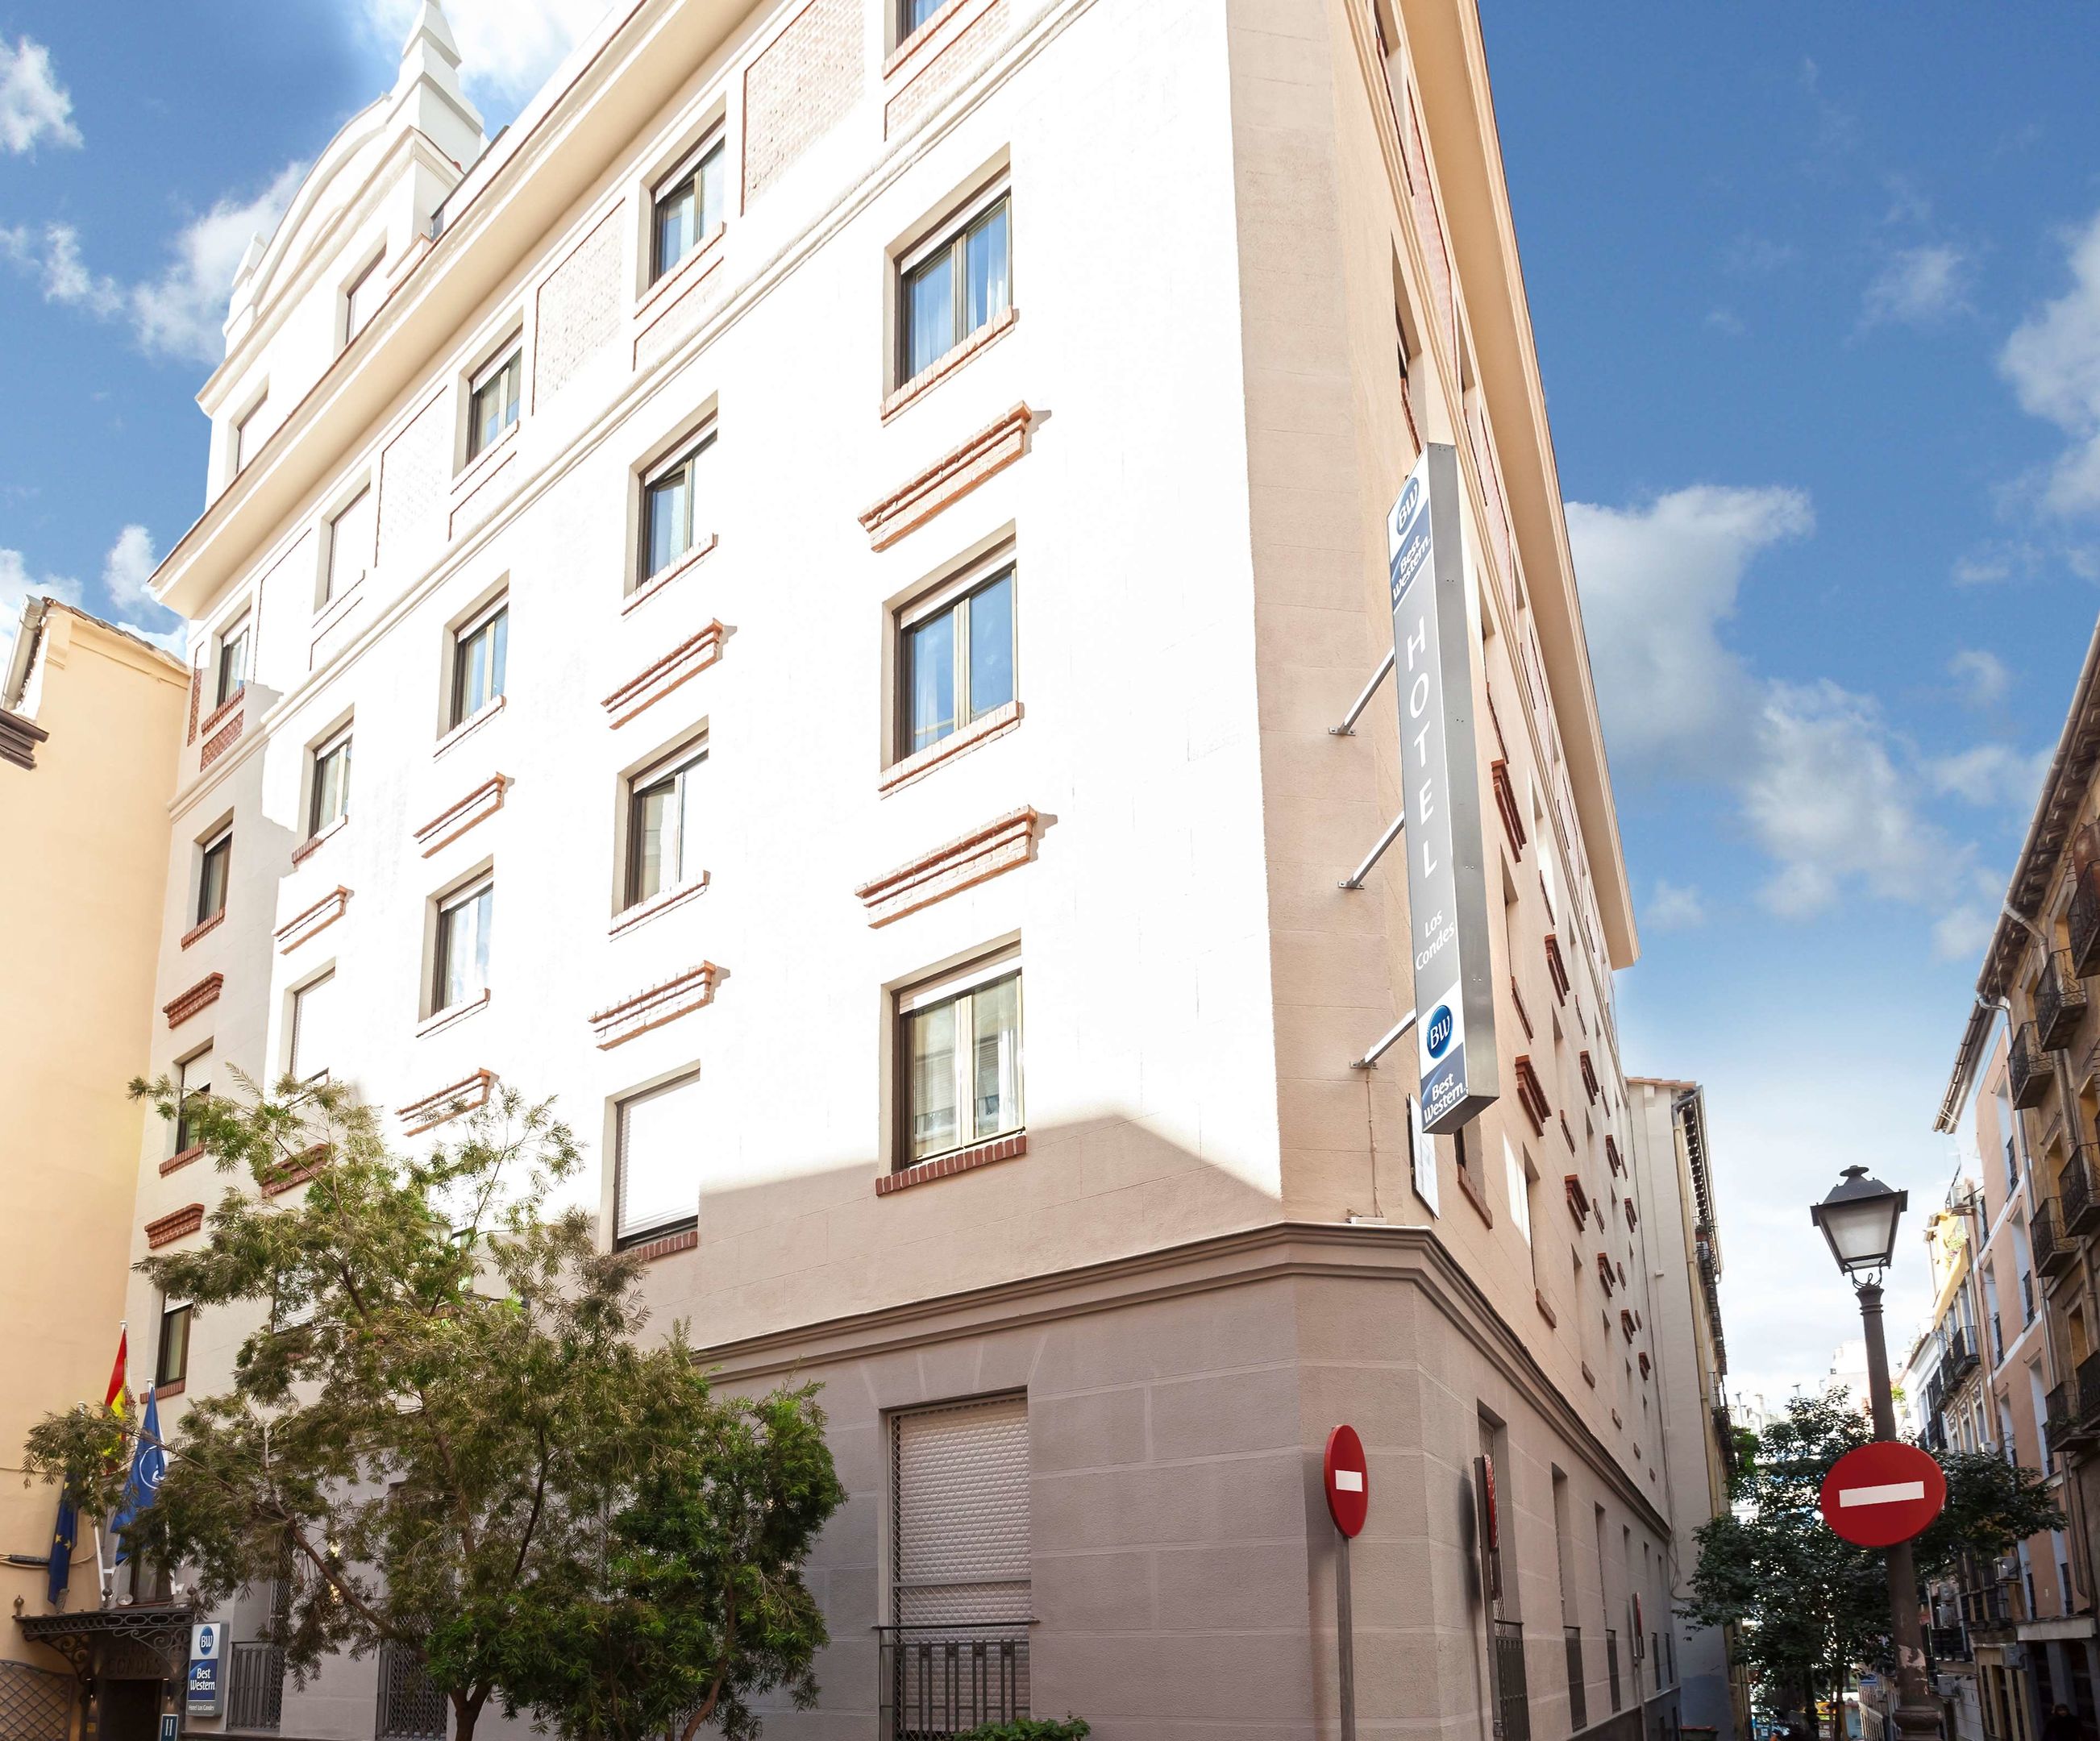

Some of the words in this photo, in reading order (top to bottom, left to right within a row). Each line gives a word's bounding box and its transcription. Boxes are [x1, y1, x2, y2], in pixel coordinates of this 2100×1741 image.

[1393, 538, 1429, 600] Western
[1399, 534, 1420, 575] Best
[1407, 616, 1438, 879] HOTEL
[1424, 910, 1443, 938] Los
[1416, 921, 1455, 970] Condes
[1430, 1015, 1450, 1049] BW
[1424, 1082, 1465, 1124] Western
[1432, 1073, 1454, 1102] Best
[201, 1635, 213, 1648] BW
[189, 1680, 215, 1691] Western
[197, 1668, 211, 1679] Best
